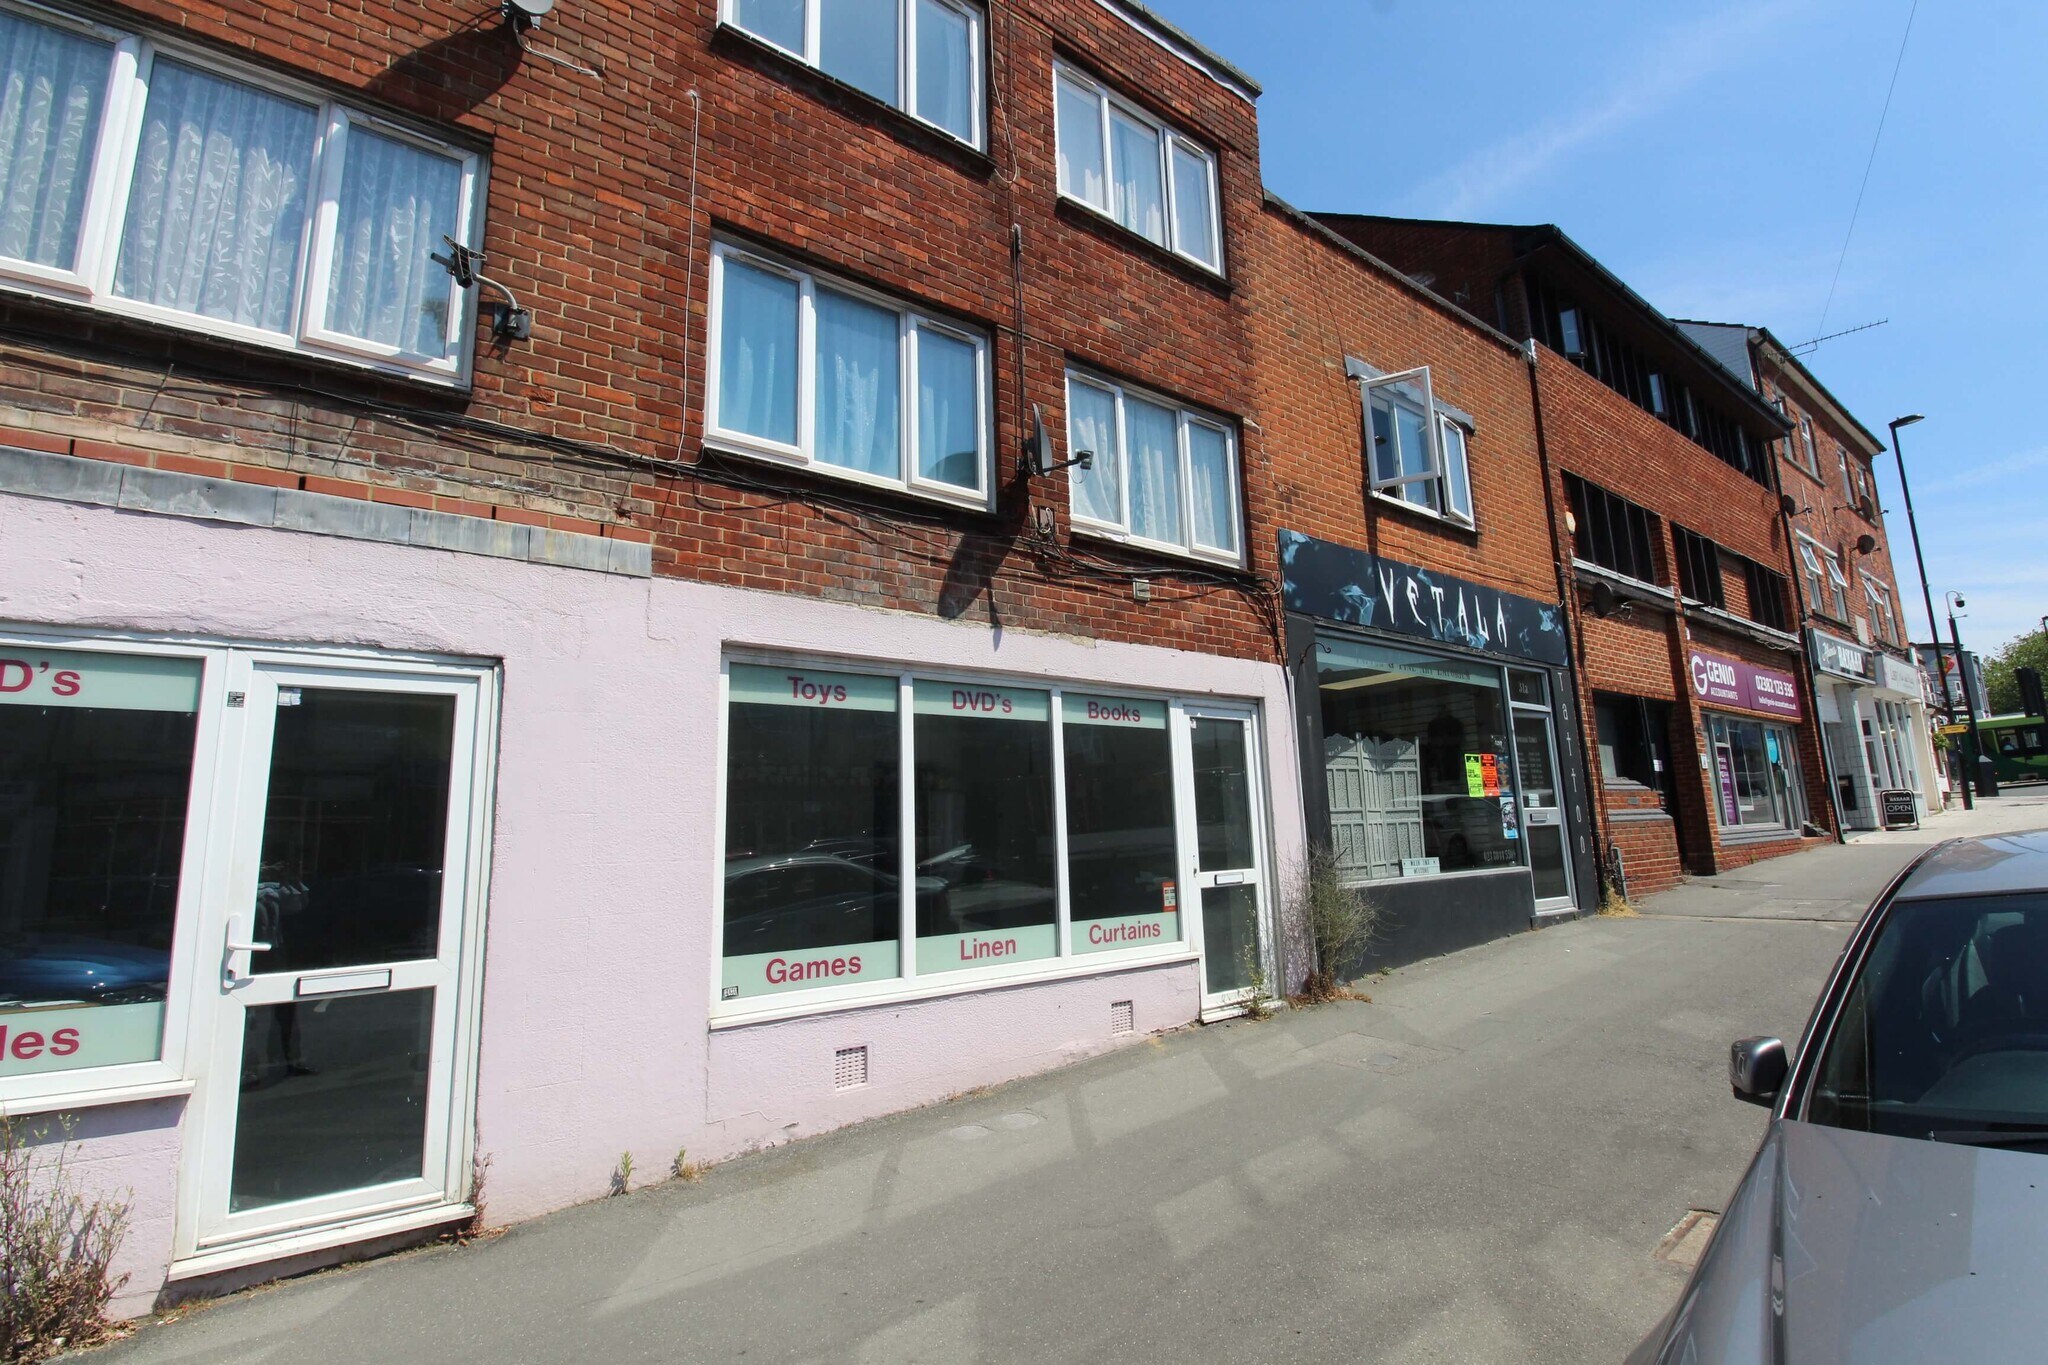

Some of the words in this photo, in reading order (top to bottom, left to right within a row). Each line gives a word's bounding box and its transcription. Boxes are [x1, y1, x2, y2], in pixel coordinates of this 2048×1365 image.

[1377, 561, 1508, 649] VETALA
[1706, 660, 1736, 687] GENIO
[787, 676, 847, 704] Toys
[952, 690, 1012, 714] DVD's
[1710, 686, 1739, 700] ACCOUNTANTS
[1087, 701, 1142, 723] Books
[1887, 804, 1912, 812] OPEN
[1088, 920, 1161, 945] Curtains
[960, 937, 1017, 961] Linen
[765, 953, 862, 984] Games
